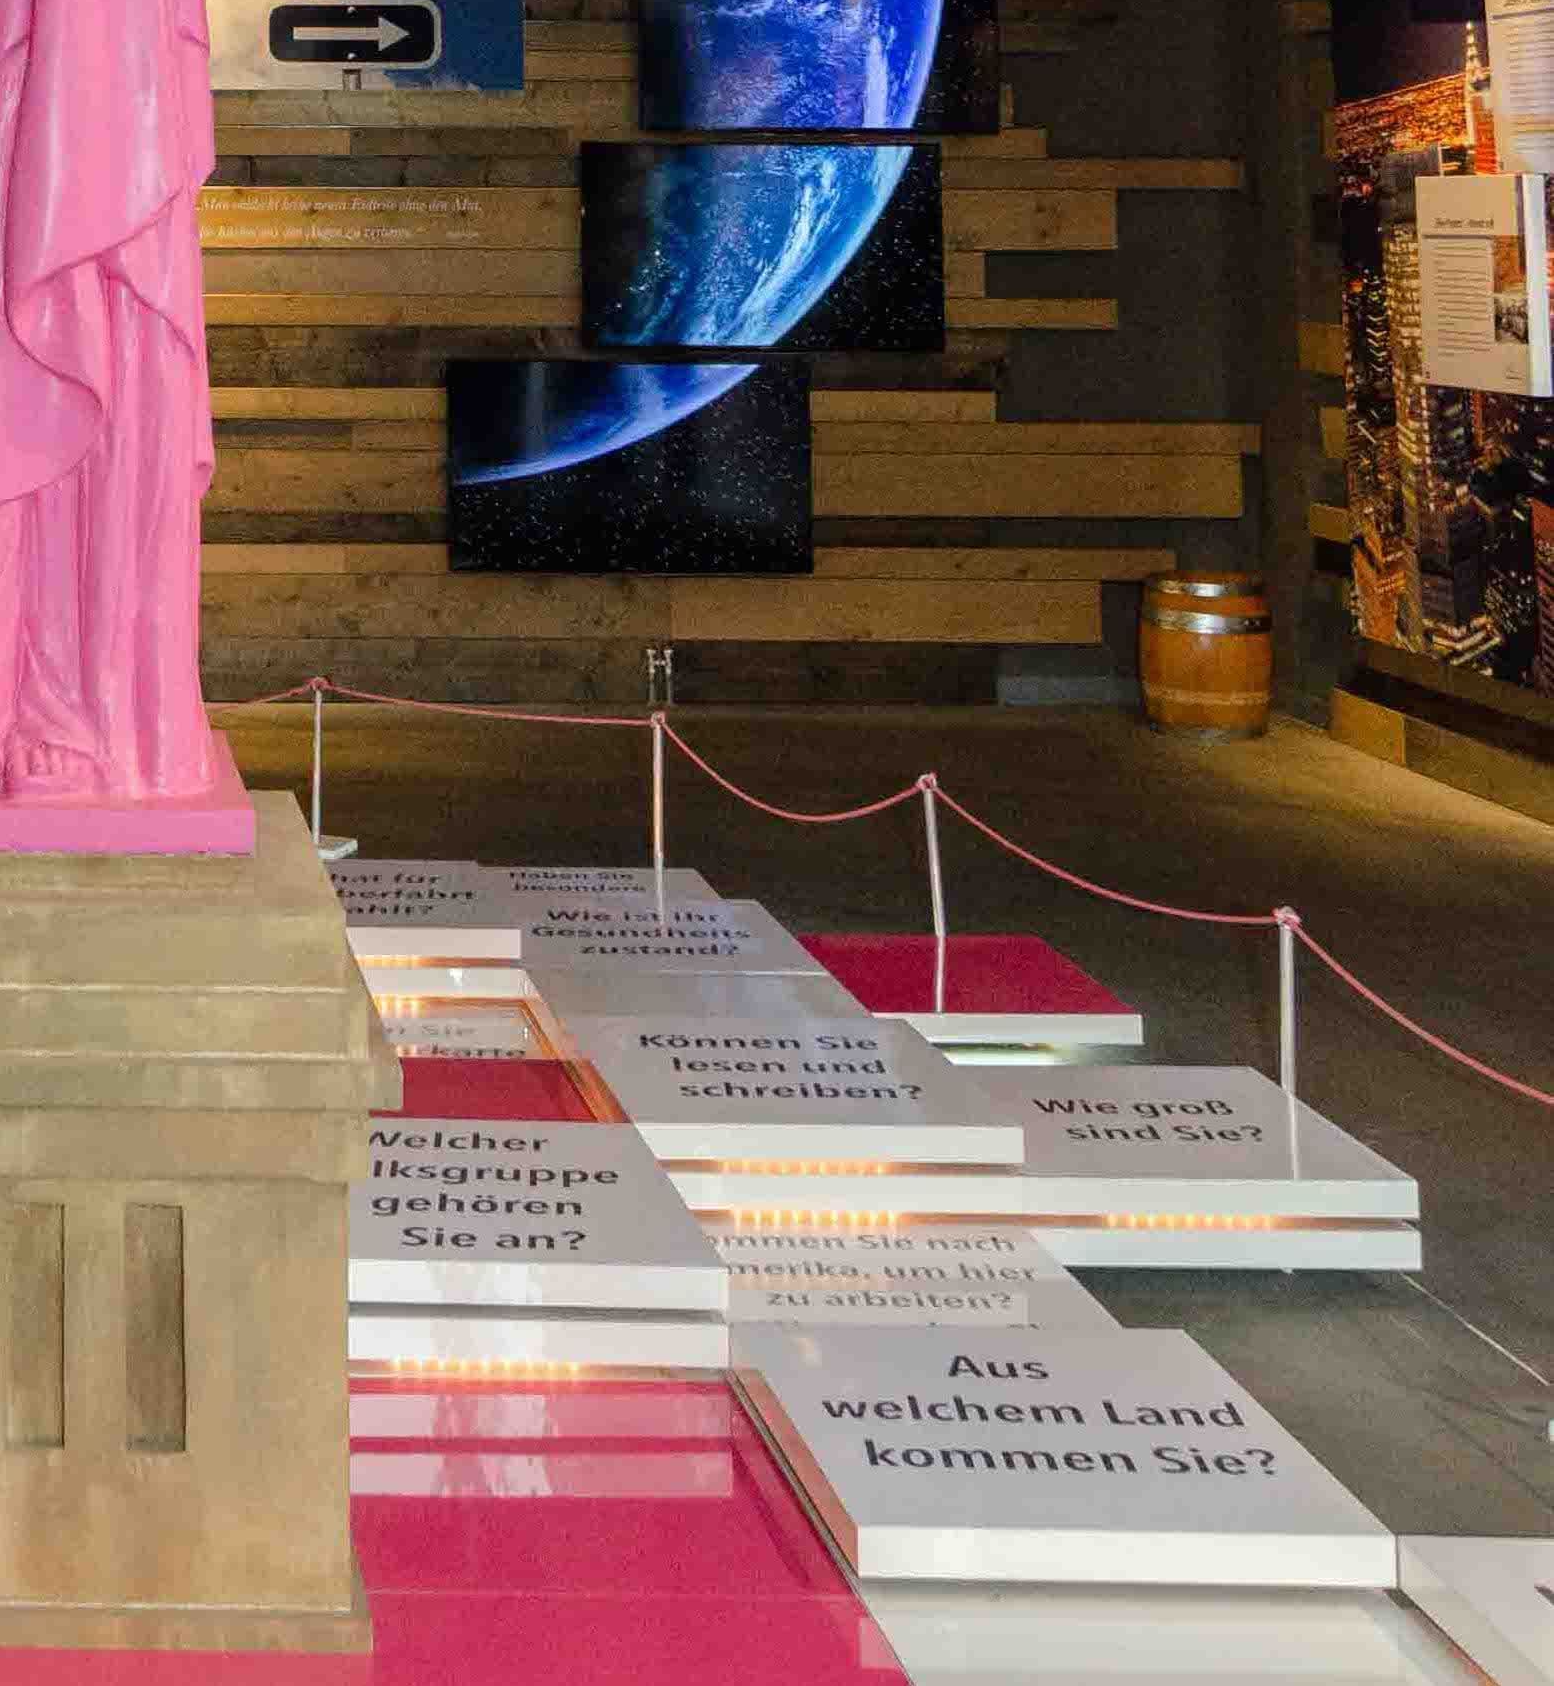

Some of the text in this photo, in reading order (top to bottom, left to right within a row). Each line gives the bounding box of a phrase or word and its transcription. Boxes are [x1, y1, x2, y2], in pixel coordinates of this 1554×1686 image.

[336, 888, 476, 901] berfahrt
[546, 909, 612, 924] Wie
[639, 1032, 879, 1052] Können Sie
[671, 1056, 886, 1076] lesen und
[679, 1080, 922, 1101] schreiben?
[1032, 1096, 1234, 1121] Wie groß
[1066, 1121, 1264, 1145] sind Sie?
[372, 1159, 621, 1188] lksgruppe
[371, 1191, 583, 1217] gehören
[401, 1225, 588, 1252] Sie an?
[705, 1233, 1017, 1252] ommen Sie nach
[725, 1260, 1037, 1283] merika, um hier
[766, 1290, 1015, 1311] zu arbeiten?
[947, 1354, 1050, 1381] Aus
[820, 1394, 1245, 1430] welchem Land
[864, 1438, 1277, 1477] kommen Sie?
